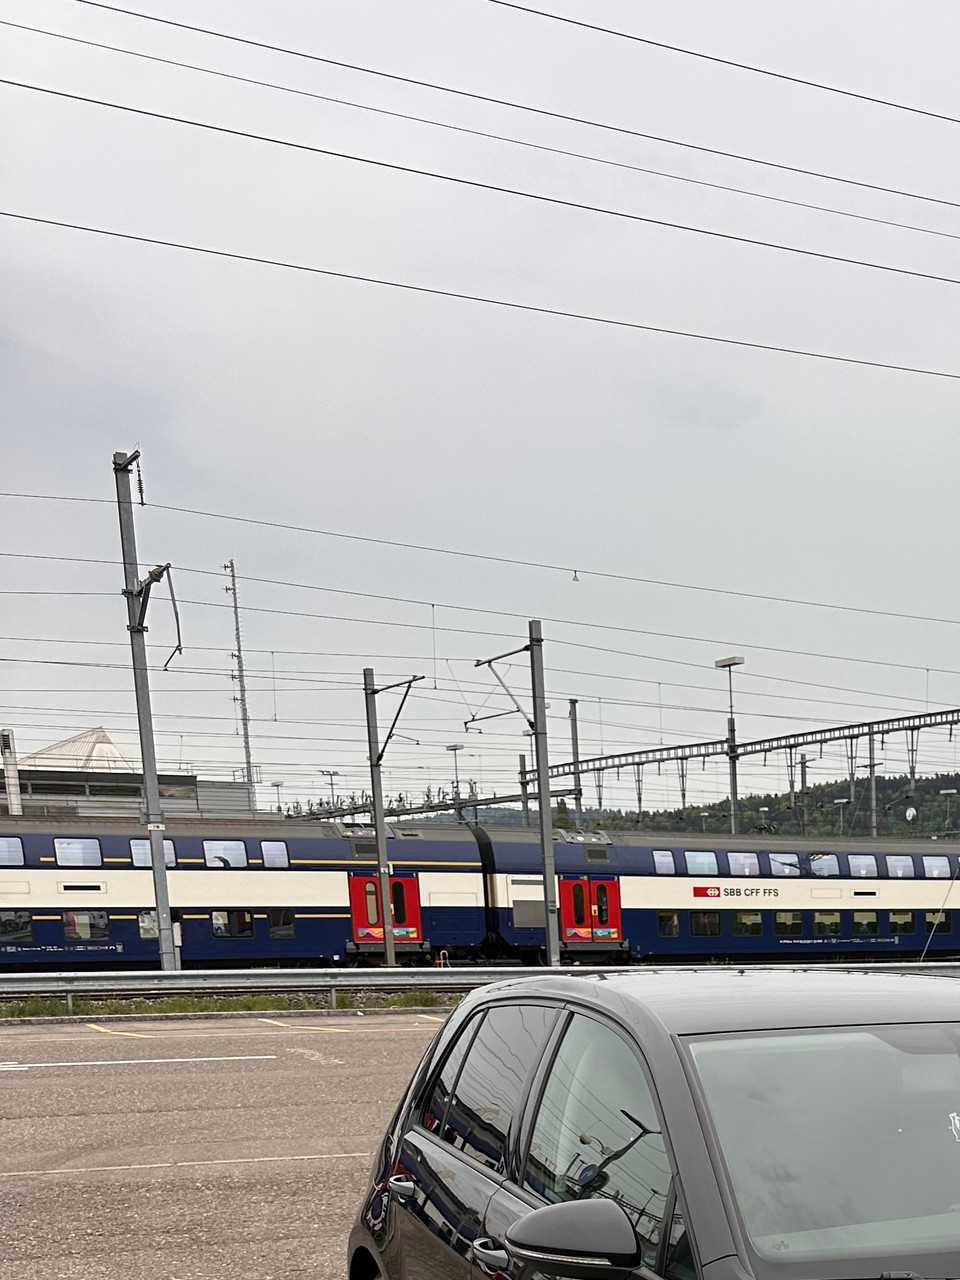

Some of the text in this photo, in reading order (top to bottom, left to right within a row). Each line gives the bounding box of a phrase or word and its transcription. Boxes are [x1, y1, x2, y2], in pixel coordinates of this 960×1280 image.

[723, 888, 779, 897] SBB CFF FFS
